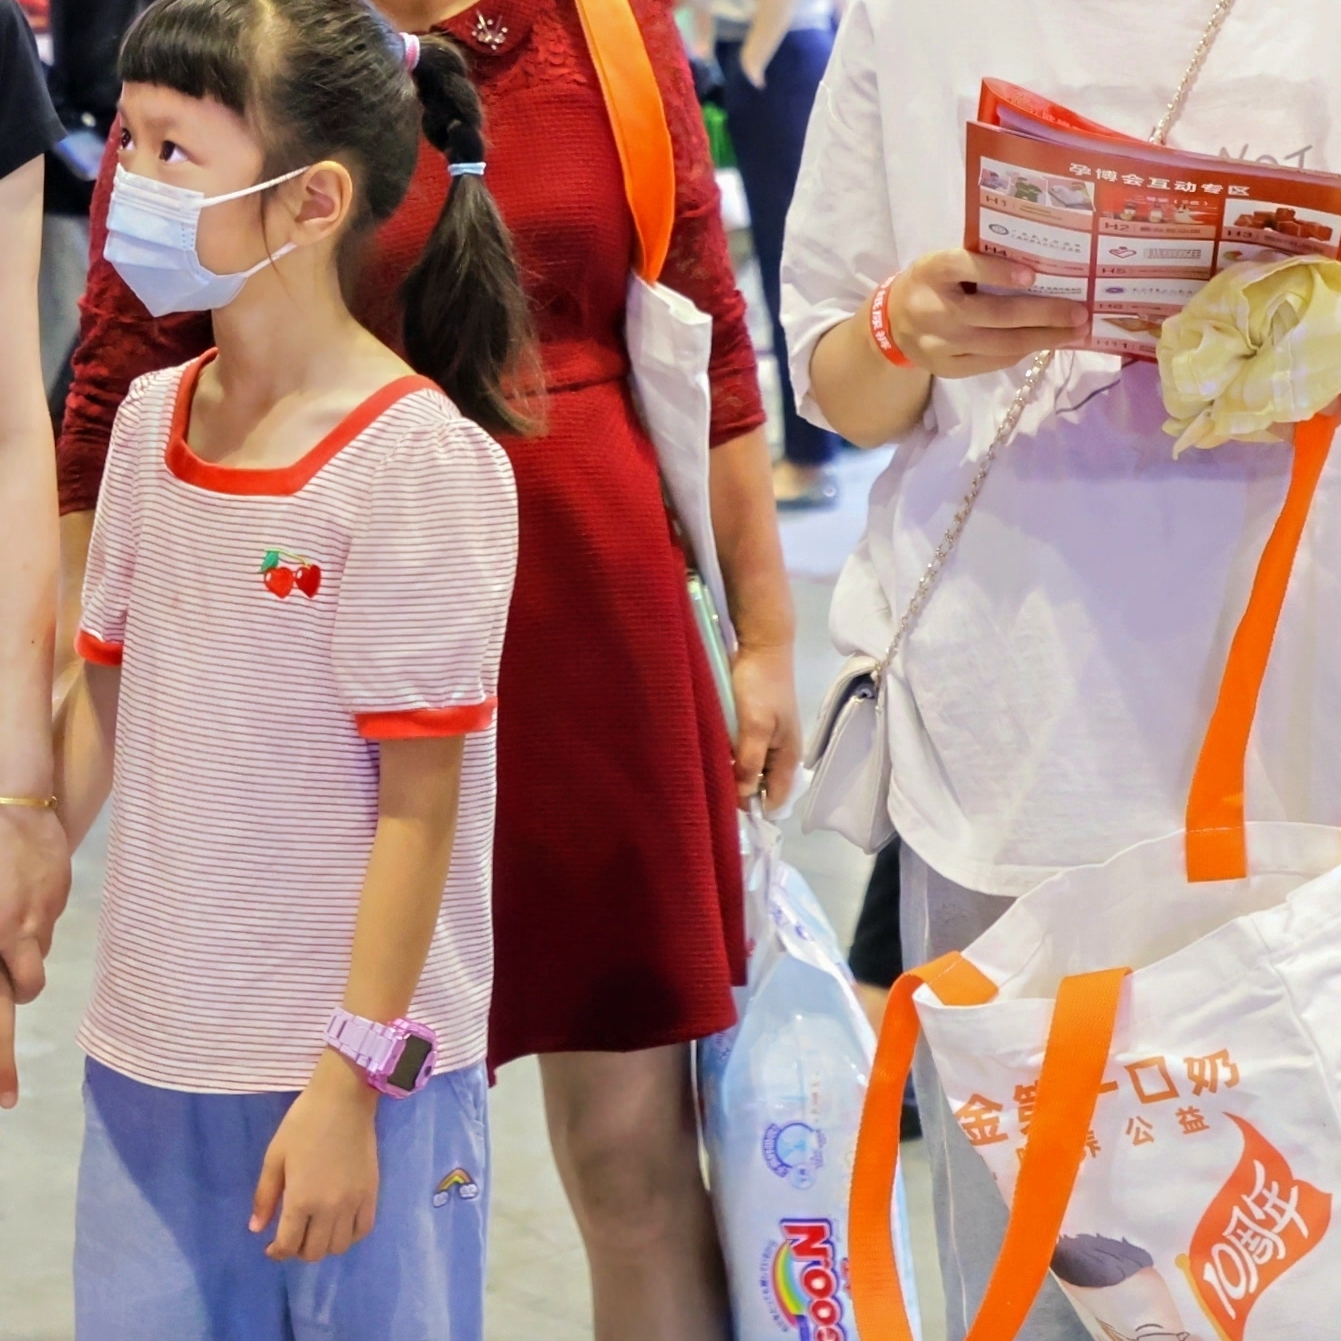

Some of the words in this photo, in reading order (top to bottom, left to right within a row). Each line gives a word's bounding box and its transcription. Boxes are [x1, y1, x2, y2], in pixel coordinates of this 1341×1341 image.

[1069, 163, 1251, 197] 孕博会互动专区
[985, 195, 1007, 207] H1
[1104, 222, 1129, 232] H2
[984, 244, 1008, 257] H4
